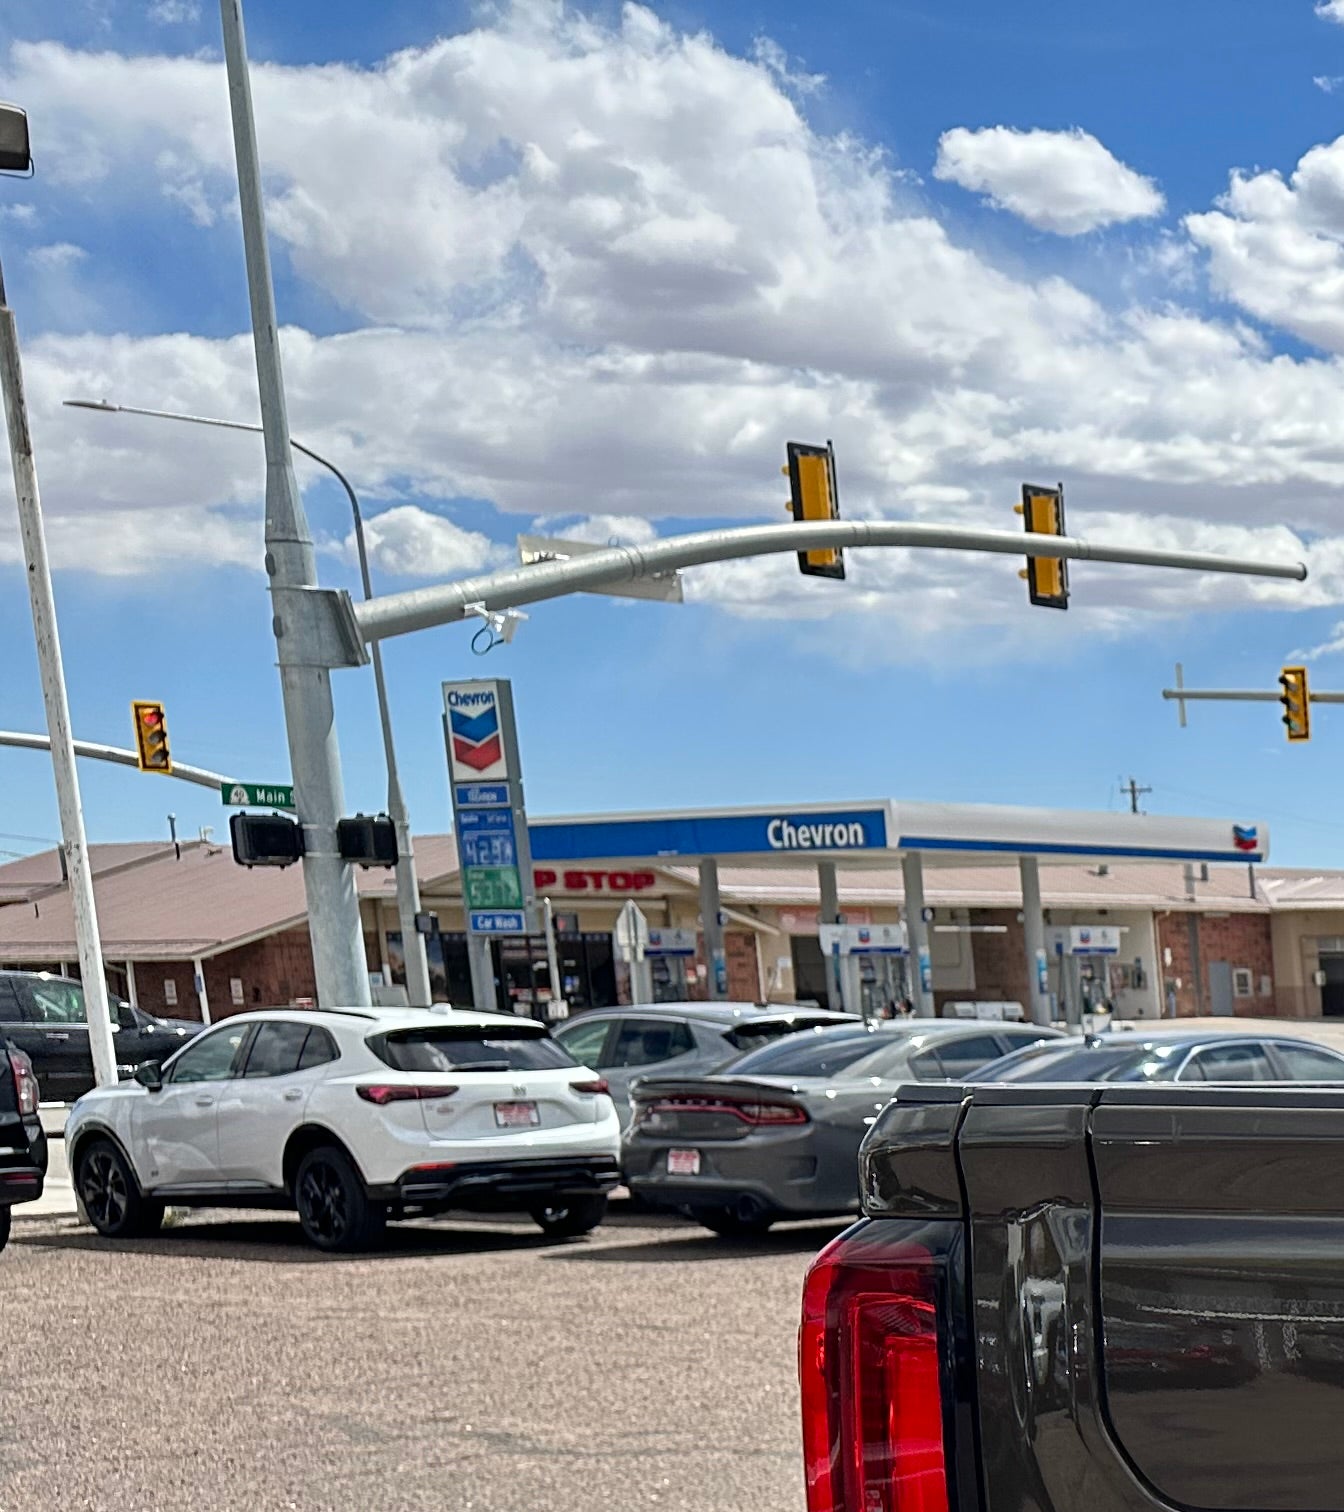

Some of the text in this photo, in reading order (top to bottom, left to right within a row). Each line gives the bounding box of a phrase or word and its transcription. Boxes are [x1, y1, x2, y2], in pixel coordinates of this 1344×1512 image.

[447, 690, 495, 706] Chevron
[256, 788, 285, 804] Main
[767, 819, 864, 849] Chevron
[564, 870, 656, 890] STOP
[478, 915, 518, 930] Car Wash
